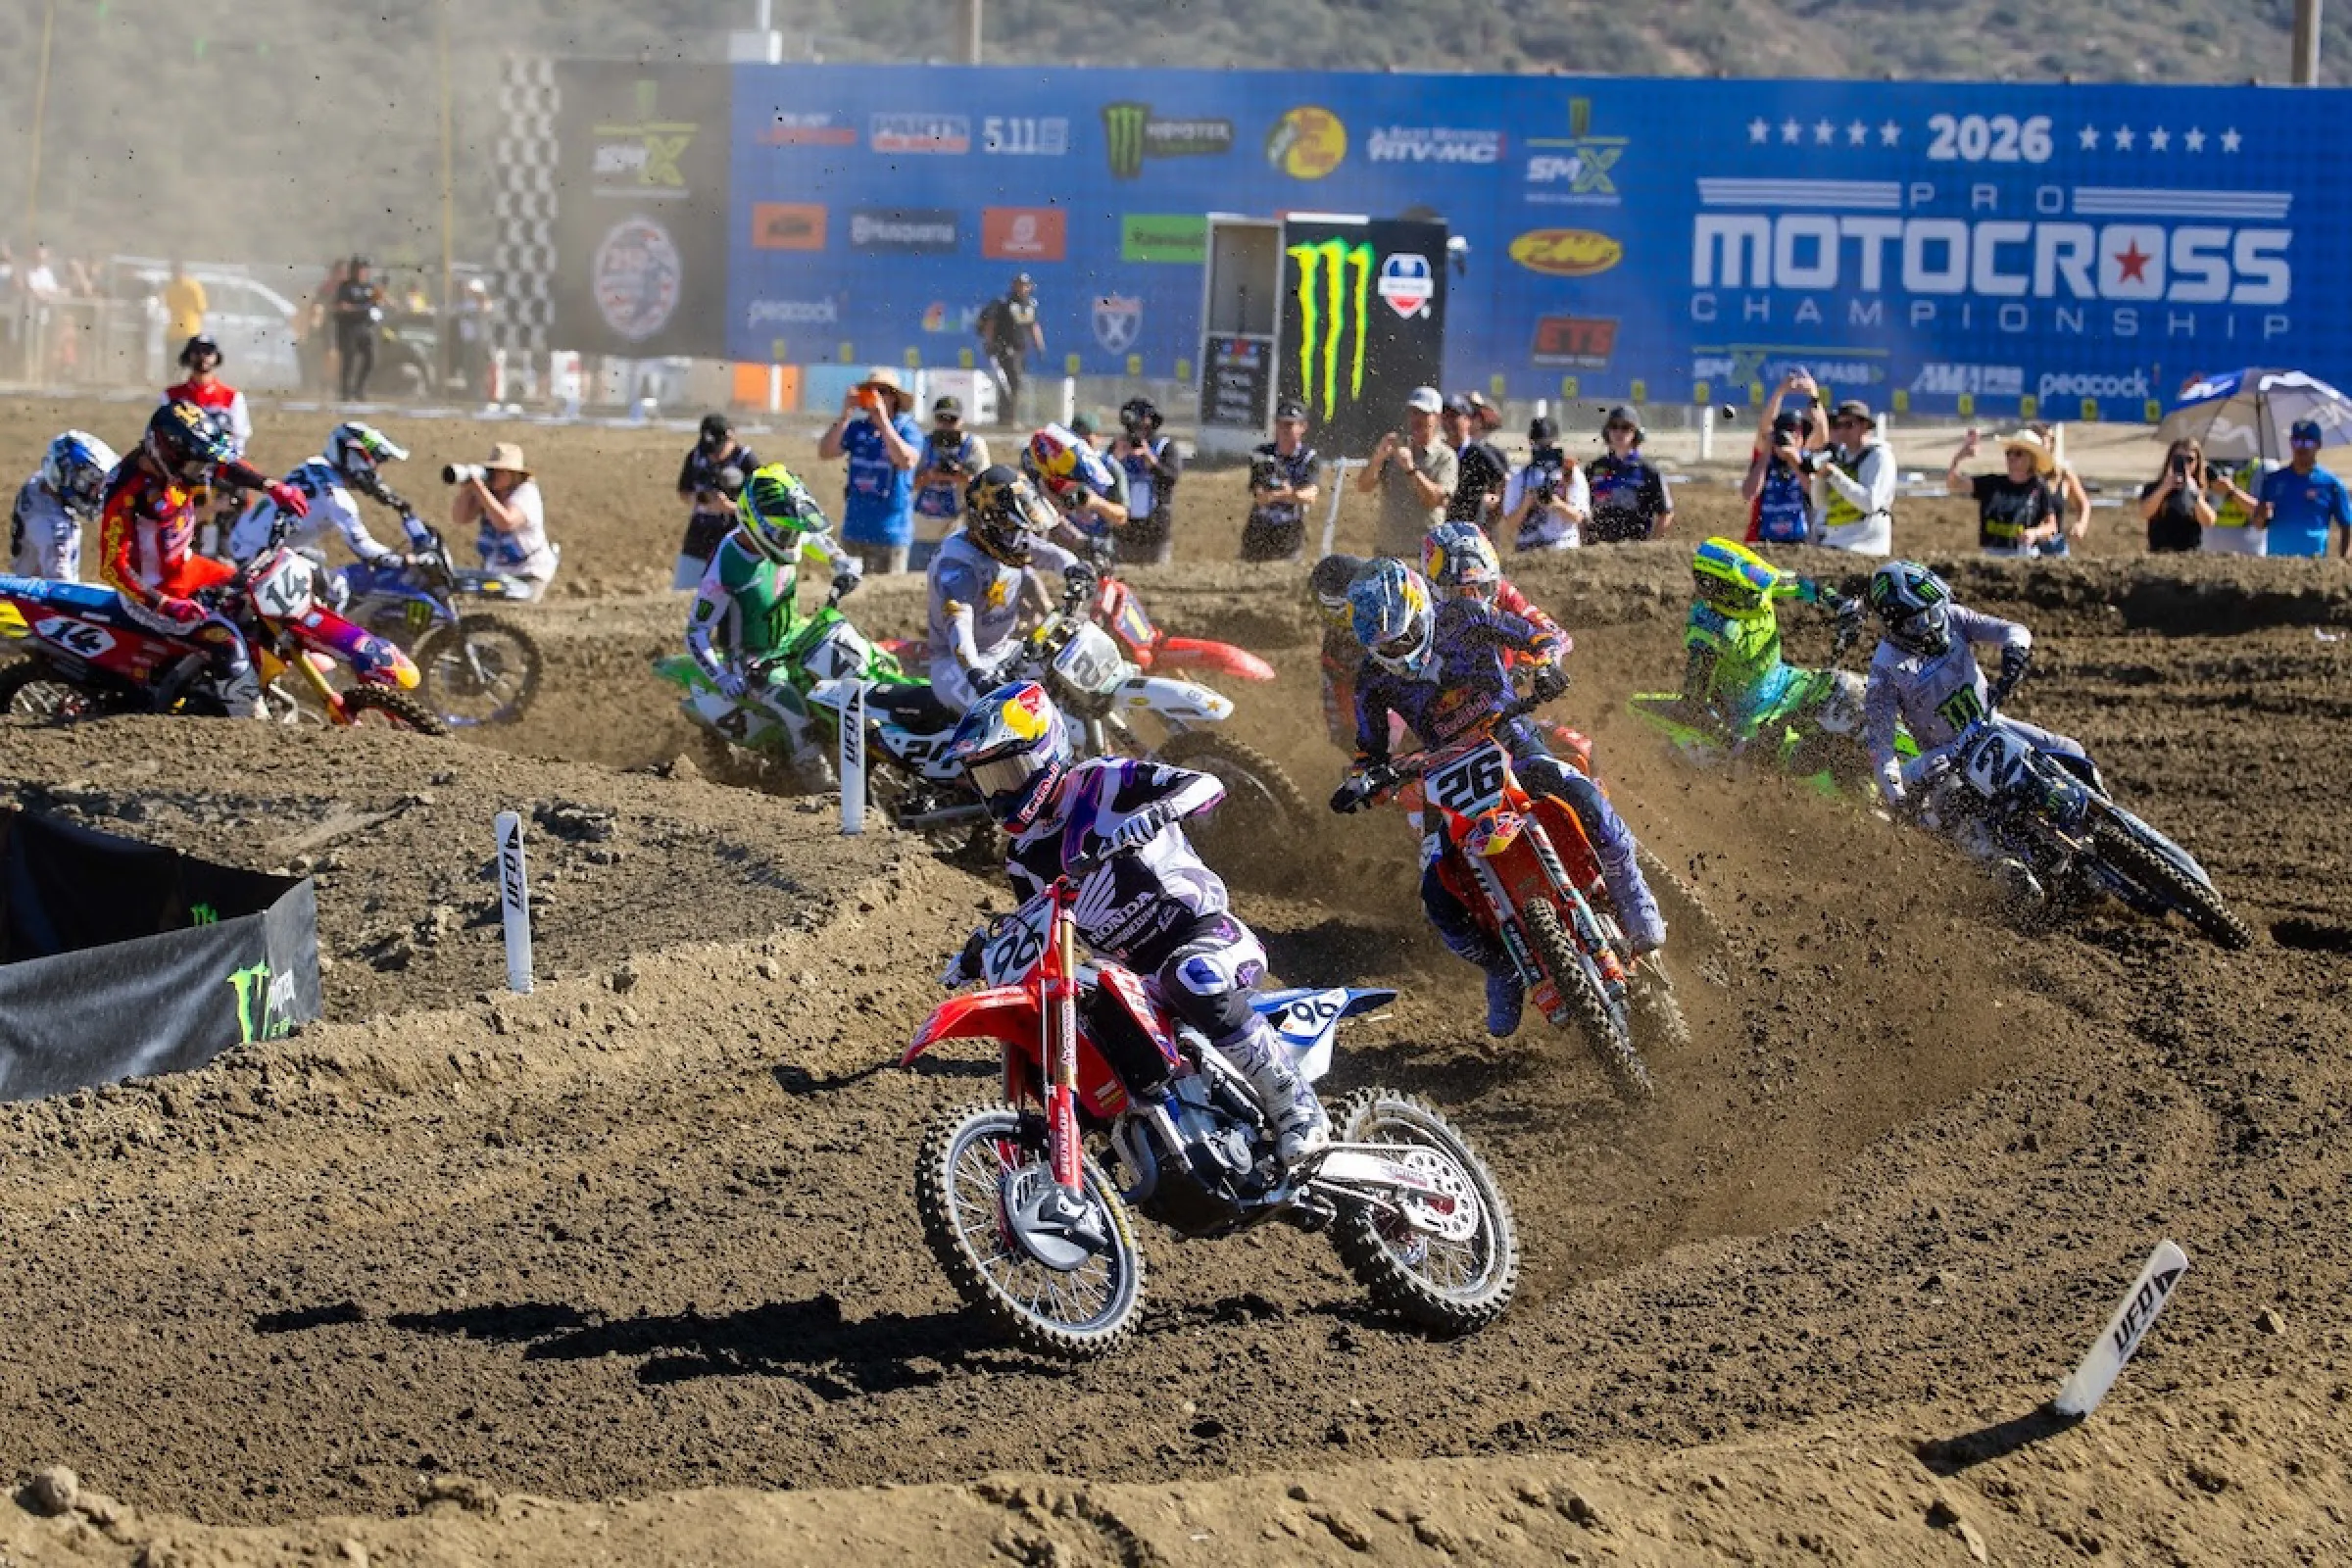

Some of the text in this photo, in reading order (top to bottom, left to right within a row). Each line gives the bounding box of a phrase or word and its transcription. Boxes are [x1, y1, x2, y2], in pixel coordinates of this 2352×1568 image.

[1927, 115, 2054, 163] 2026
[1525, 146, 1624, 194] SMX
[1910, 183, 2064, 213] PRO
[1690, 213, 2293, 305] MOTOCROSS
[1690, 298, 2291, 339] CHAMPIONSHIP
[2038, 368, 2149, 404] peacock
[266, 566, 310, 615] 14
[49, 618, 104, 656] 14
[845, 714, 858, 764] UFO
[1437, 750, 1505, 812] 26
[503, 853, 520, 909] UFO
[1087, 891, 1159, 945] HONDA
[992, 930, 1045, 976] 96
[1291, 999, 1338, 1029] 96
[1058, 1106, 1072, 1177] DUNLOP
[2112, 1281, 2153, 1352] UFO
